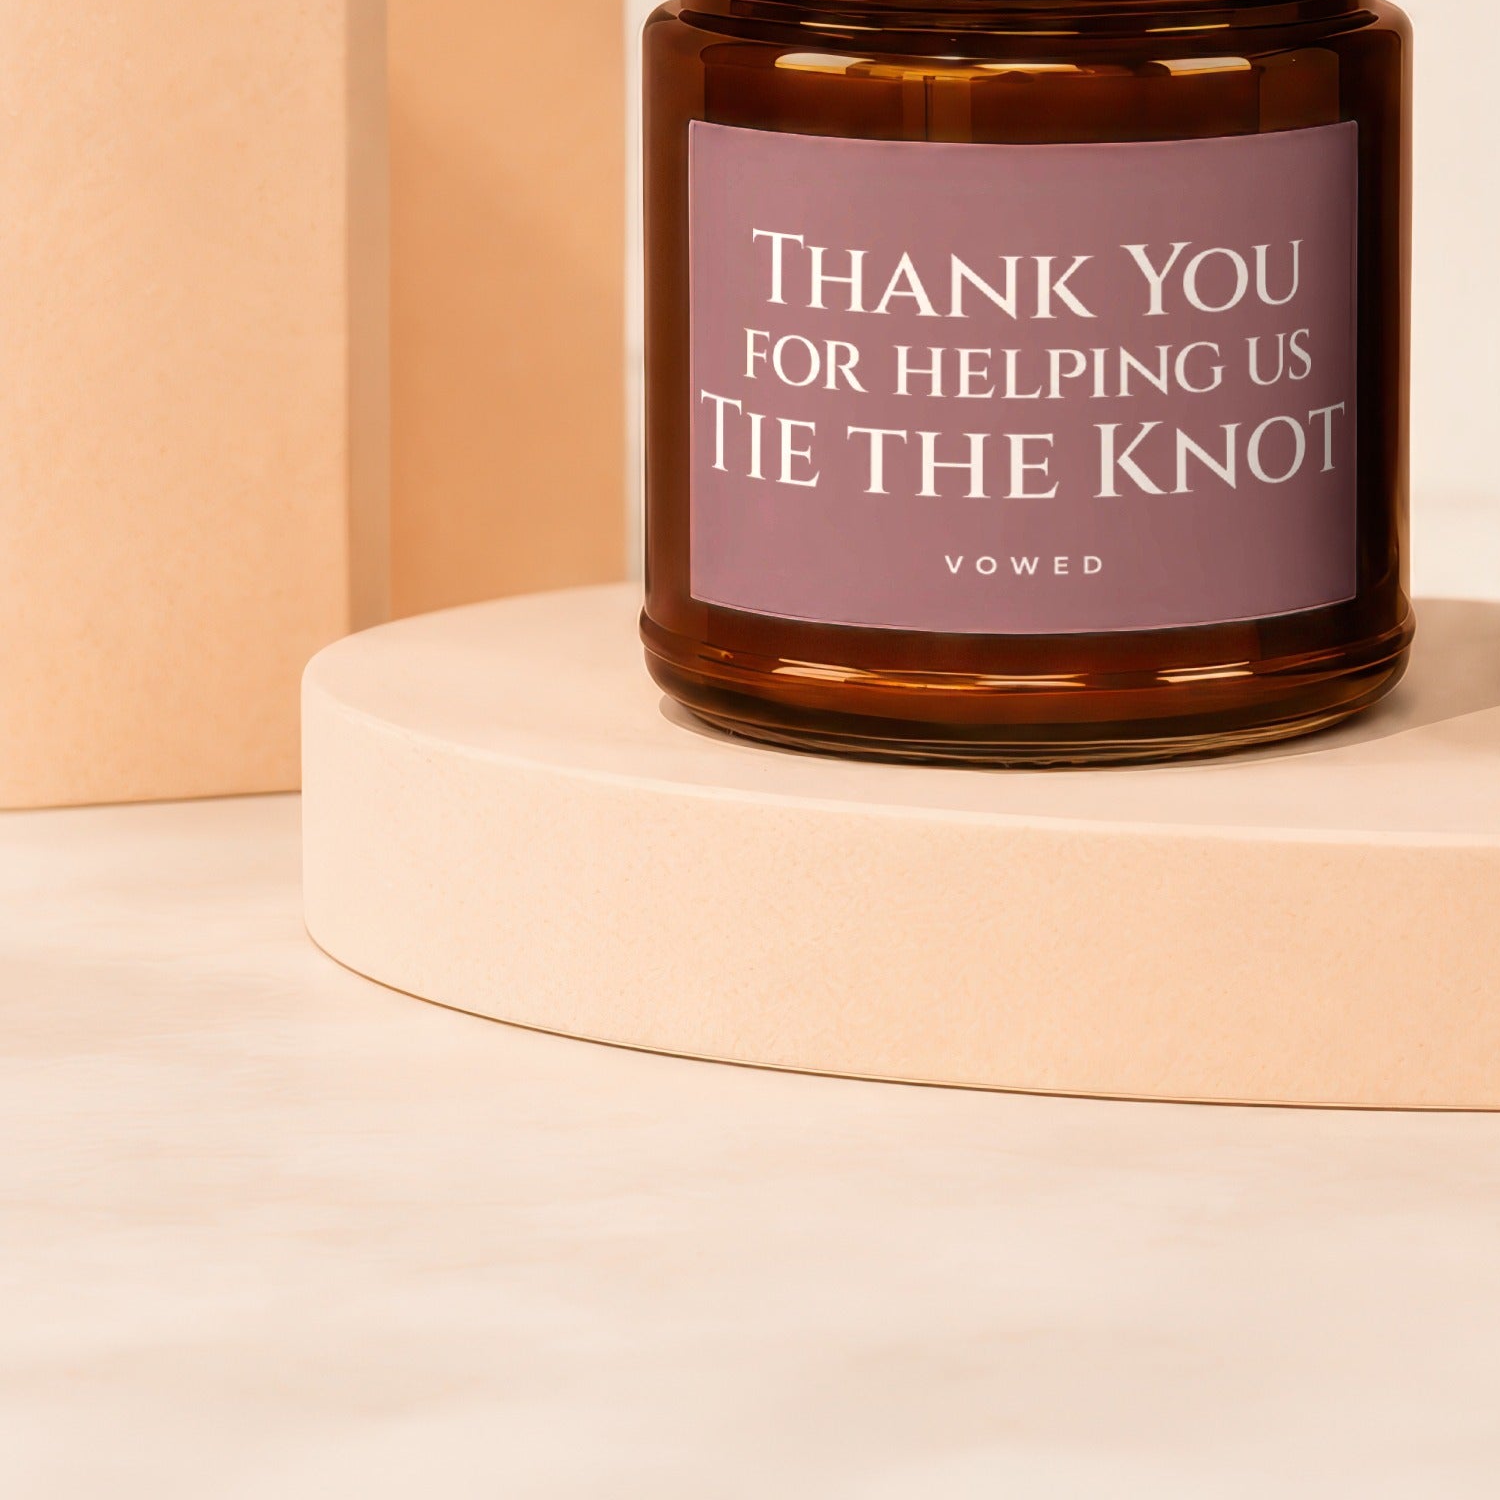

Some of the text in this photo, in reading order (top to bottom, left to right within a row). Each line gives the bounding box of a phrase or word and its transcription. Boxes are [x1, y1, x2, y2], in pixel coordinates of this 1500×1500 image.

[753, 228, 1303, 319] THANK YOU
[744, 328, 1311, 398] FOR HELPING US
[701, 388, 1344, 498] TIE THE KNOT
[945, 555, 1102, 575] VOWED
